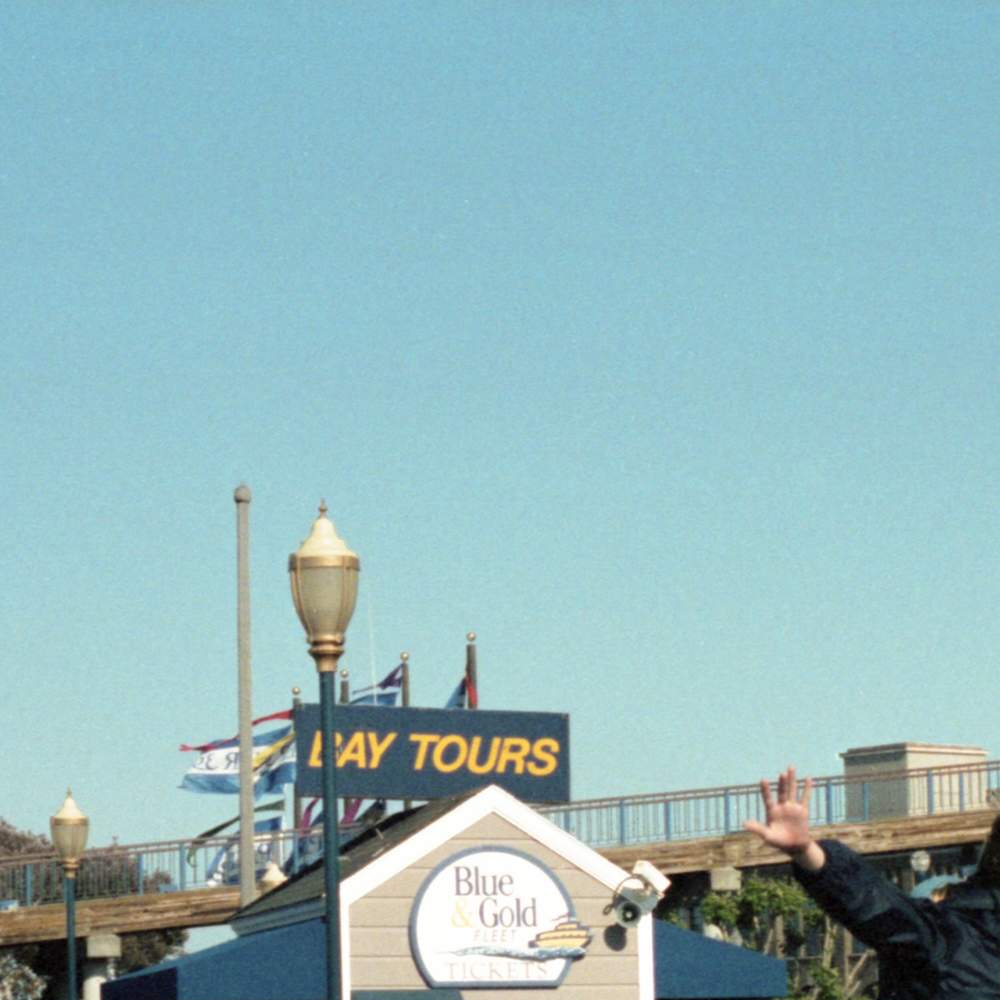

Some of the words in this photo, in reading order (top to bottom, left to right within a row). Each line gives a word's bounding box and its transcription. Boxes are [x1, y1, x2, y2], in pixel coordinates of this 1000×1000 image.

[409, 733, 560, 776] TOURS
[454, 866, 514, 896] Blue
[451, 899, 473, 928] &
[479, 897, 537, 928] Gold
[472, 928, 518, 942] FLEET
[445, 960, 547, 979] TICKETS
